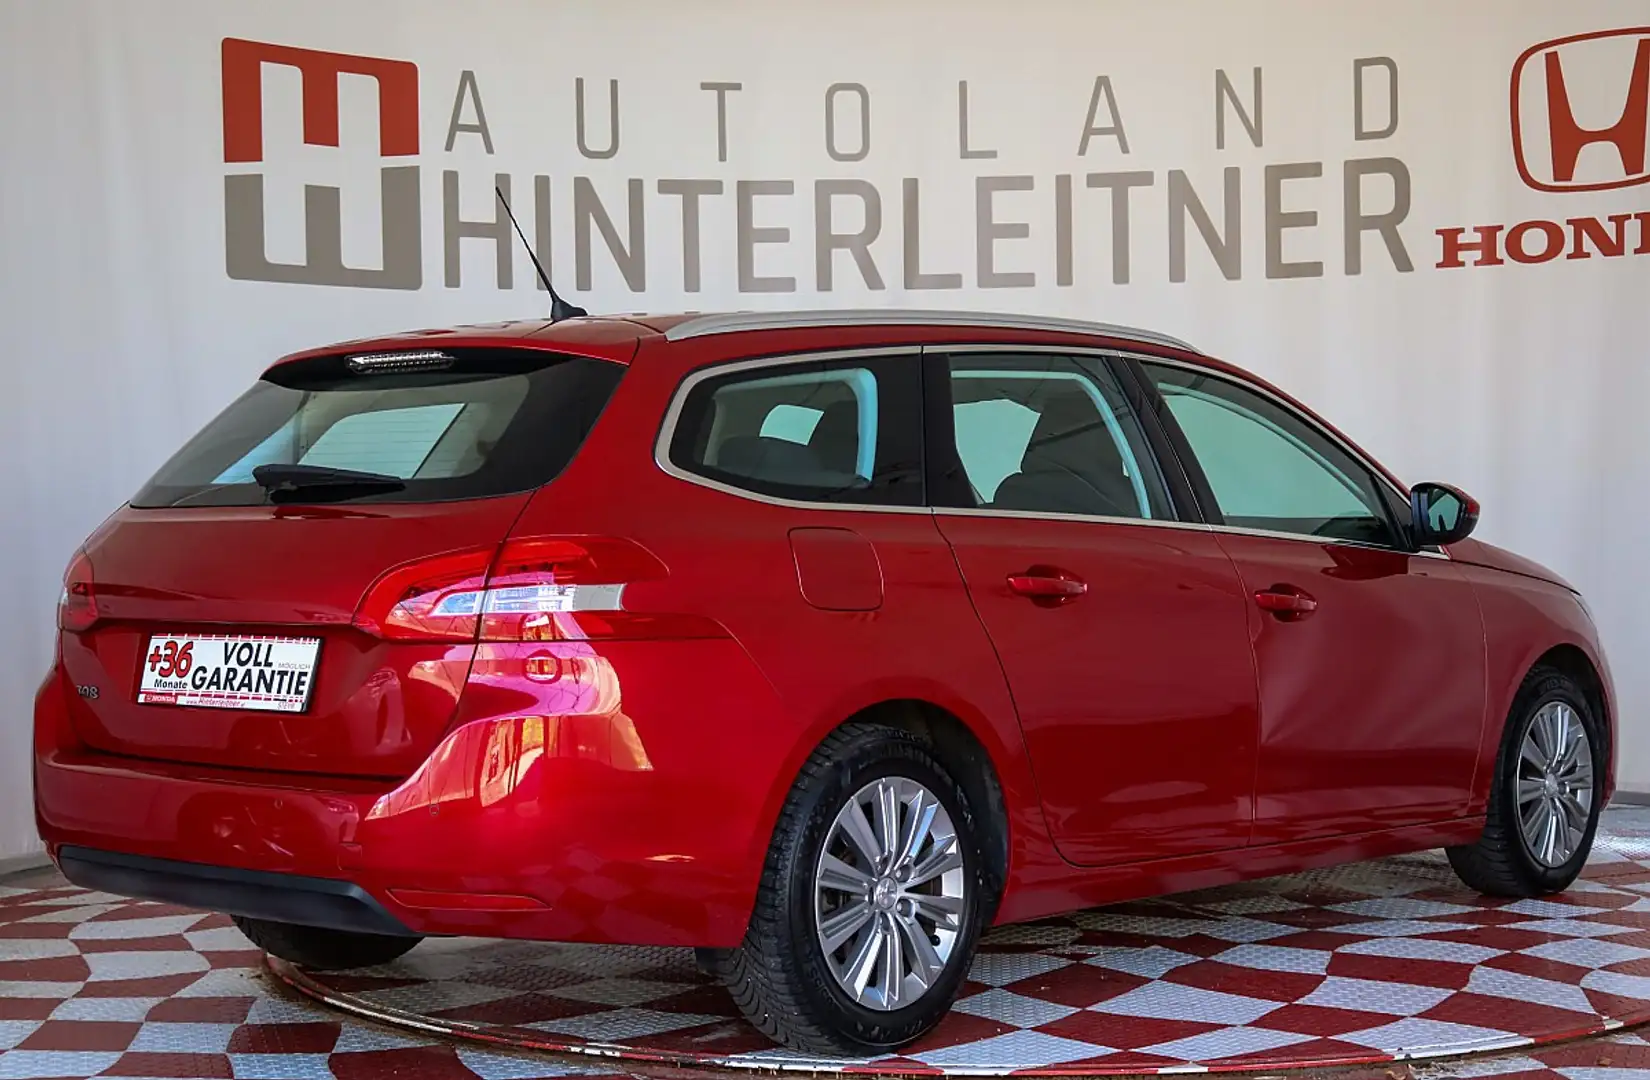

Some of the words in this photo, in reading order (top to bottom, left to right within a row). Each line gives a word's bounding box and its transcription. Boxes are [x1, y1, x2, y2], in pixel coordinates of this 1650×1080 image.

[444, 56, 1398, 162] AUTOLAND
[442, 157, 1415, 292] HINTERLEITNER
[1435, 211, 1650, 268] HON
[148, 640, 194, 678] +36
[224, 642, 273, 667] VOLL
[154, 678, 188, 689] Monate
[192, 666, 308, 695] GARANTIE
